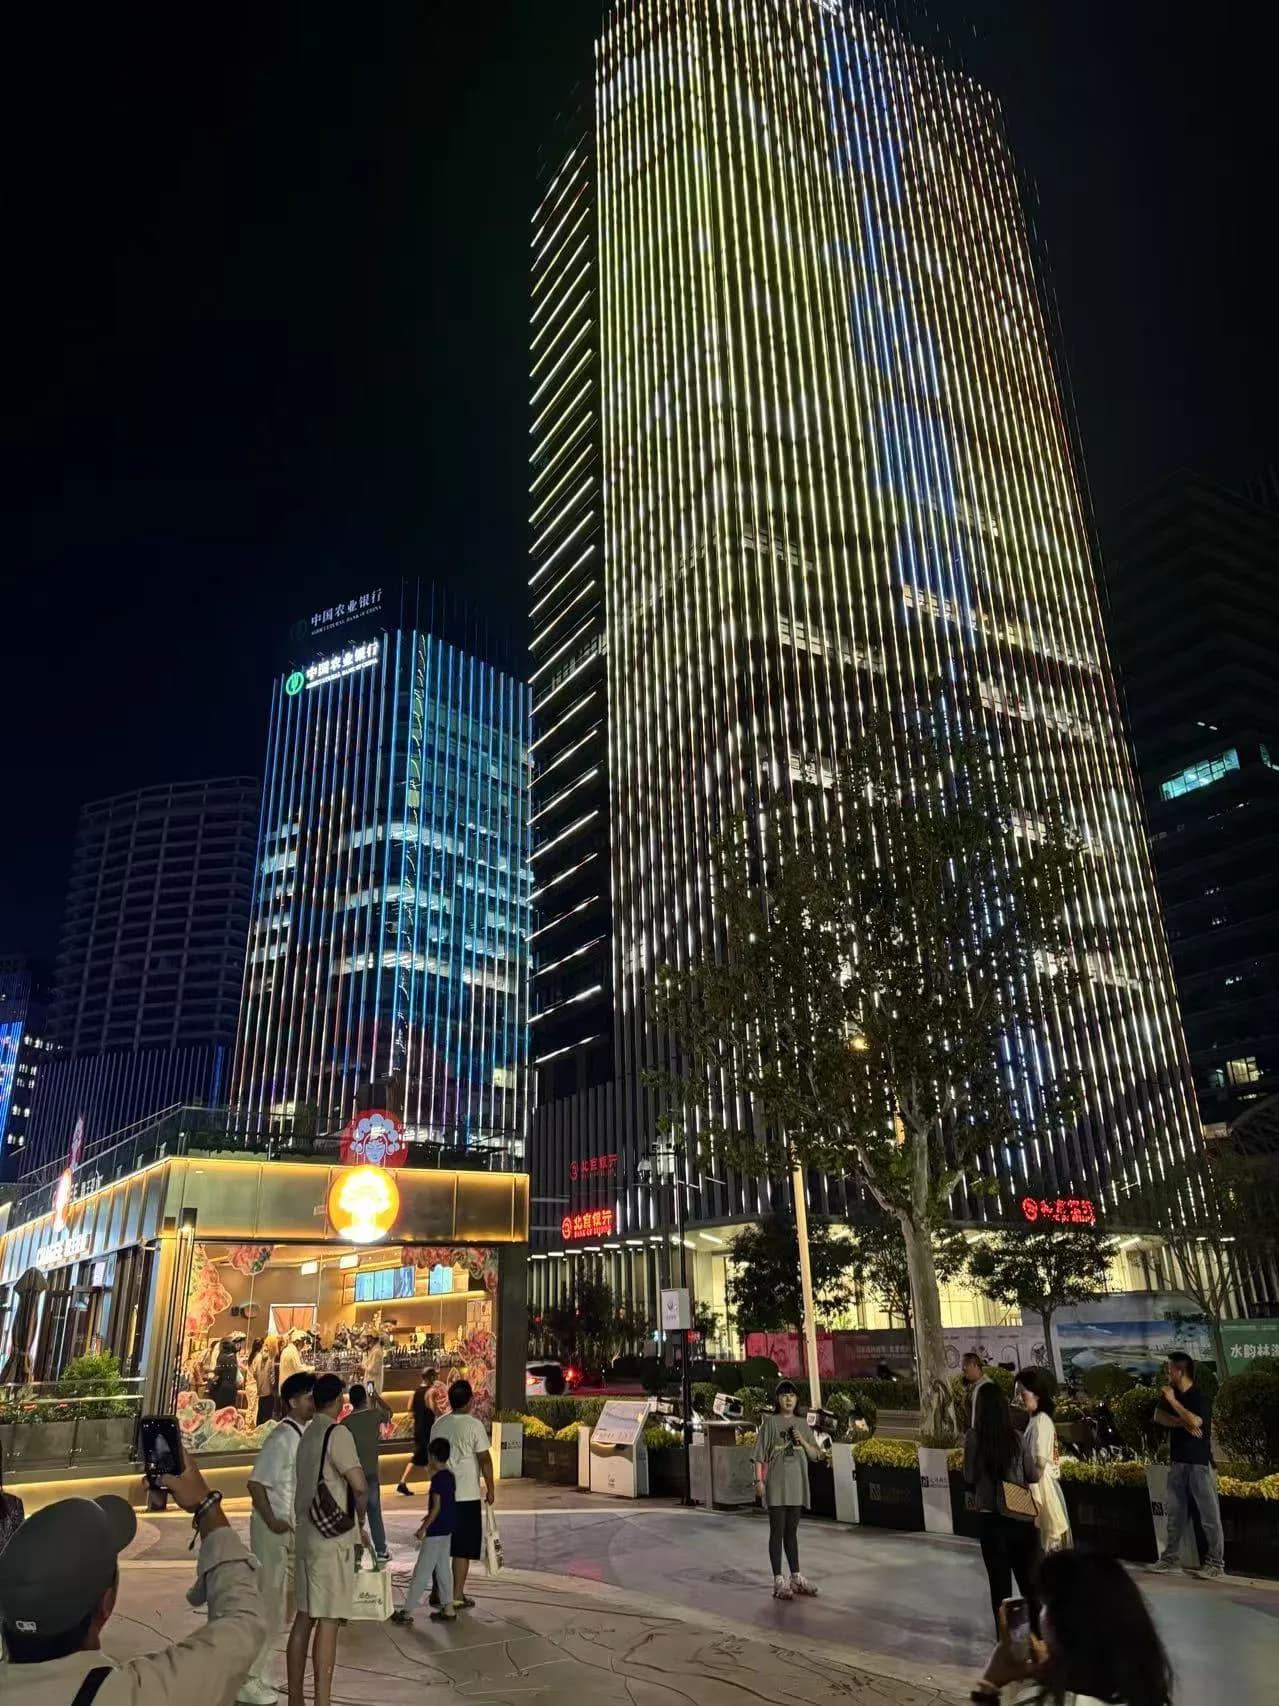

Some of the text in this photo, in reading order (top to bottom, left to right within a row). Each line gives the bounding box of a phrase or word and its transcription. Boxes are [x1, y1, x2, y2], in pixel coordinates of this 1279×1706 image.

[311, 588, 382, 627] 中国农业银行
[306, 641, 379, 681] 中国农业银行
[573, 1210, 613, 1231] 北京银行
